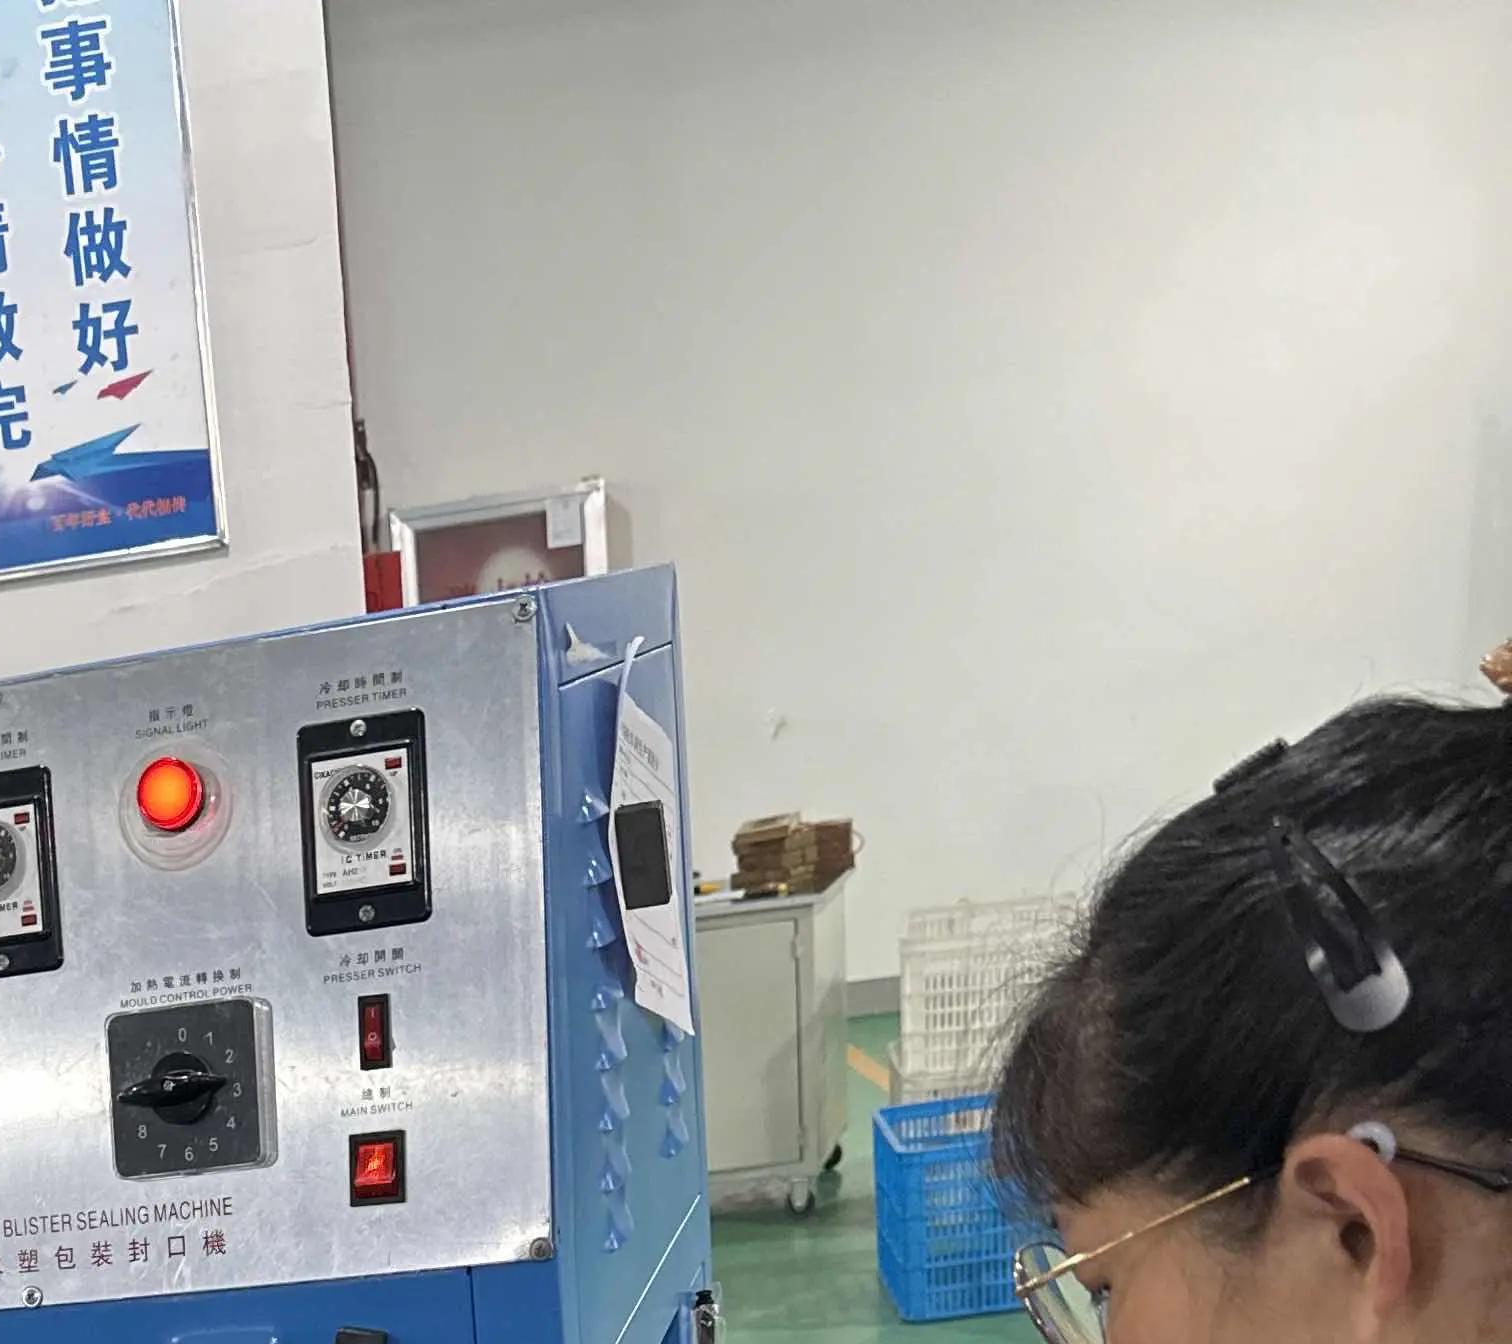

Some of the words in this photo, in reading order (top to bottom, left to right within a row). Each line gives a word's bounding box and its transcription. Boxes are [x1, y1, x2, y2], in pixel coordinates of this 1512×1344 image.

[39, 0, 140, 375] 事情做好
[316, 694, 370, 710] PRESSER
[372, 688, 407, 703] TIMER
[136, 724, 175, 739] SIGNAL
[175, 719, 208, 732] LIGHT
[341, 855, 352, 864] IC
[357, 850, 387, 861] TIMER
[323, 967, 376, 985] PRESSER
[376, 963, 422, 978] SWITCH
[120, 995, 157, 1010] MOULD
[158, 989, 211, 1005] CONTROL
[212, 983, 253, 999] POWER
[177, 1027, 188, 1043] 0
[206, 1031, 215, 1046] 1
[224, 1050, 235, 1064] 2
[232, 1083, 242, 1098] 3
[340, 1104, 369, 1119] MAIN
[369, 1101, 414, 1115] SWITCH
[226, 1115, 237, 1130] 4
[137, 1124, 148, 1140] 8
[157, 1144, 168, 1160] 7
[208, 1137, 219, 1152] 5
[184, 1146, 195, 1162] 6
[2, 1214, 73, 1238] BLISTER
[75, 1205, 150, 1232] SEALING
[153, 1196, 234, 1224] MACHINE
